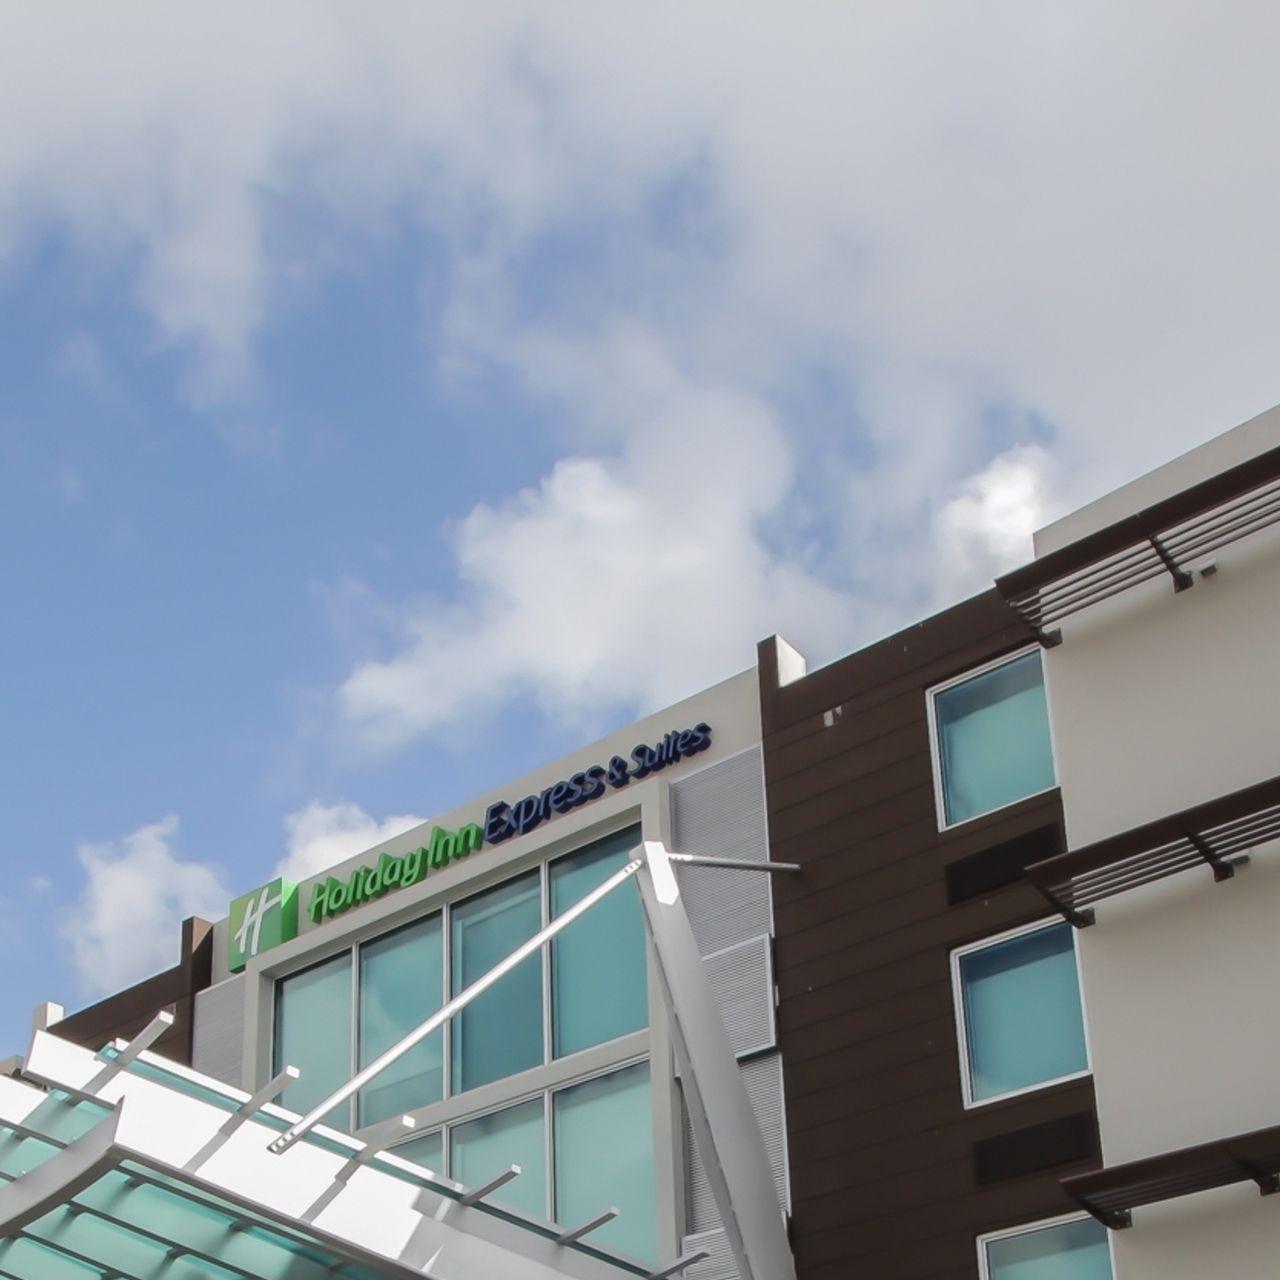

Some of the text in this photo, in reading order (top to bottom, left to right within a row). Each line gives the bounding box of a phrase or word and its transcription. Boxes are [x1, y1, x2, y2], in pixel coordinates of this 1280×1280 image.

[309, 722, 712, 924] Holiday Inn Express & Suites
